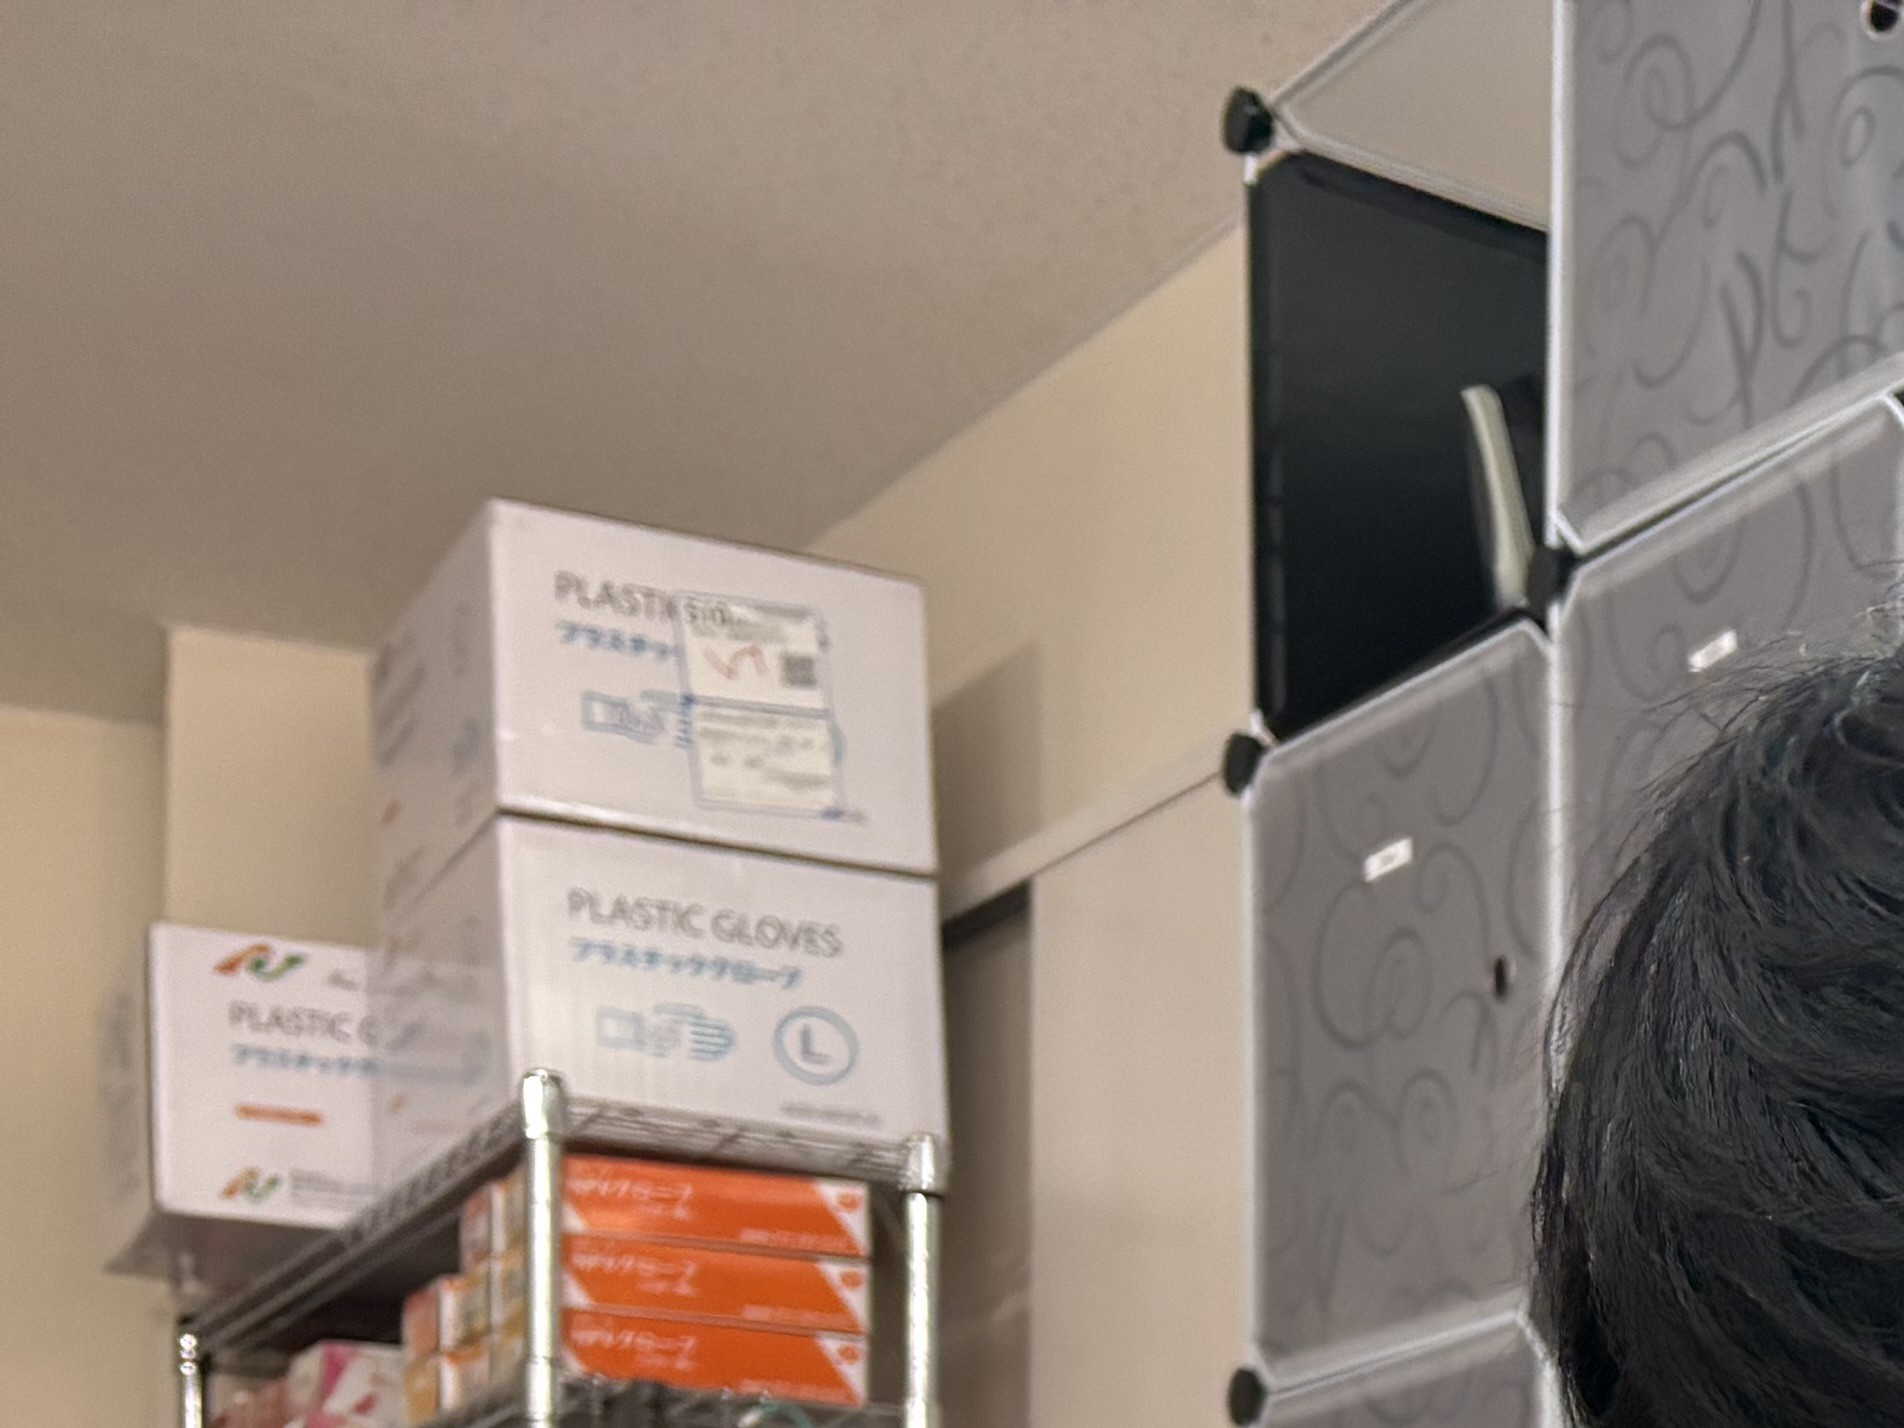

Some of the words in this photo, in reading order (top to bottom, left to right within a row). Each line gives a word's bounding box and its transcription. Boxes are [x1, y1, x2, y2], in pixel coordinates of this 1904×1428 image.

[567, 887, 706, 938] PLASTIC
[710, 908, 844, 957] GLOVES
[801, 1022, 829, 1066] L
